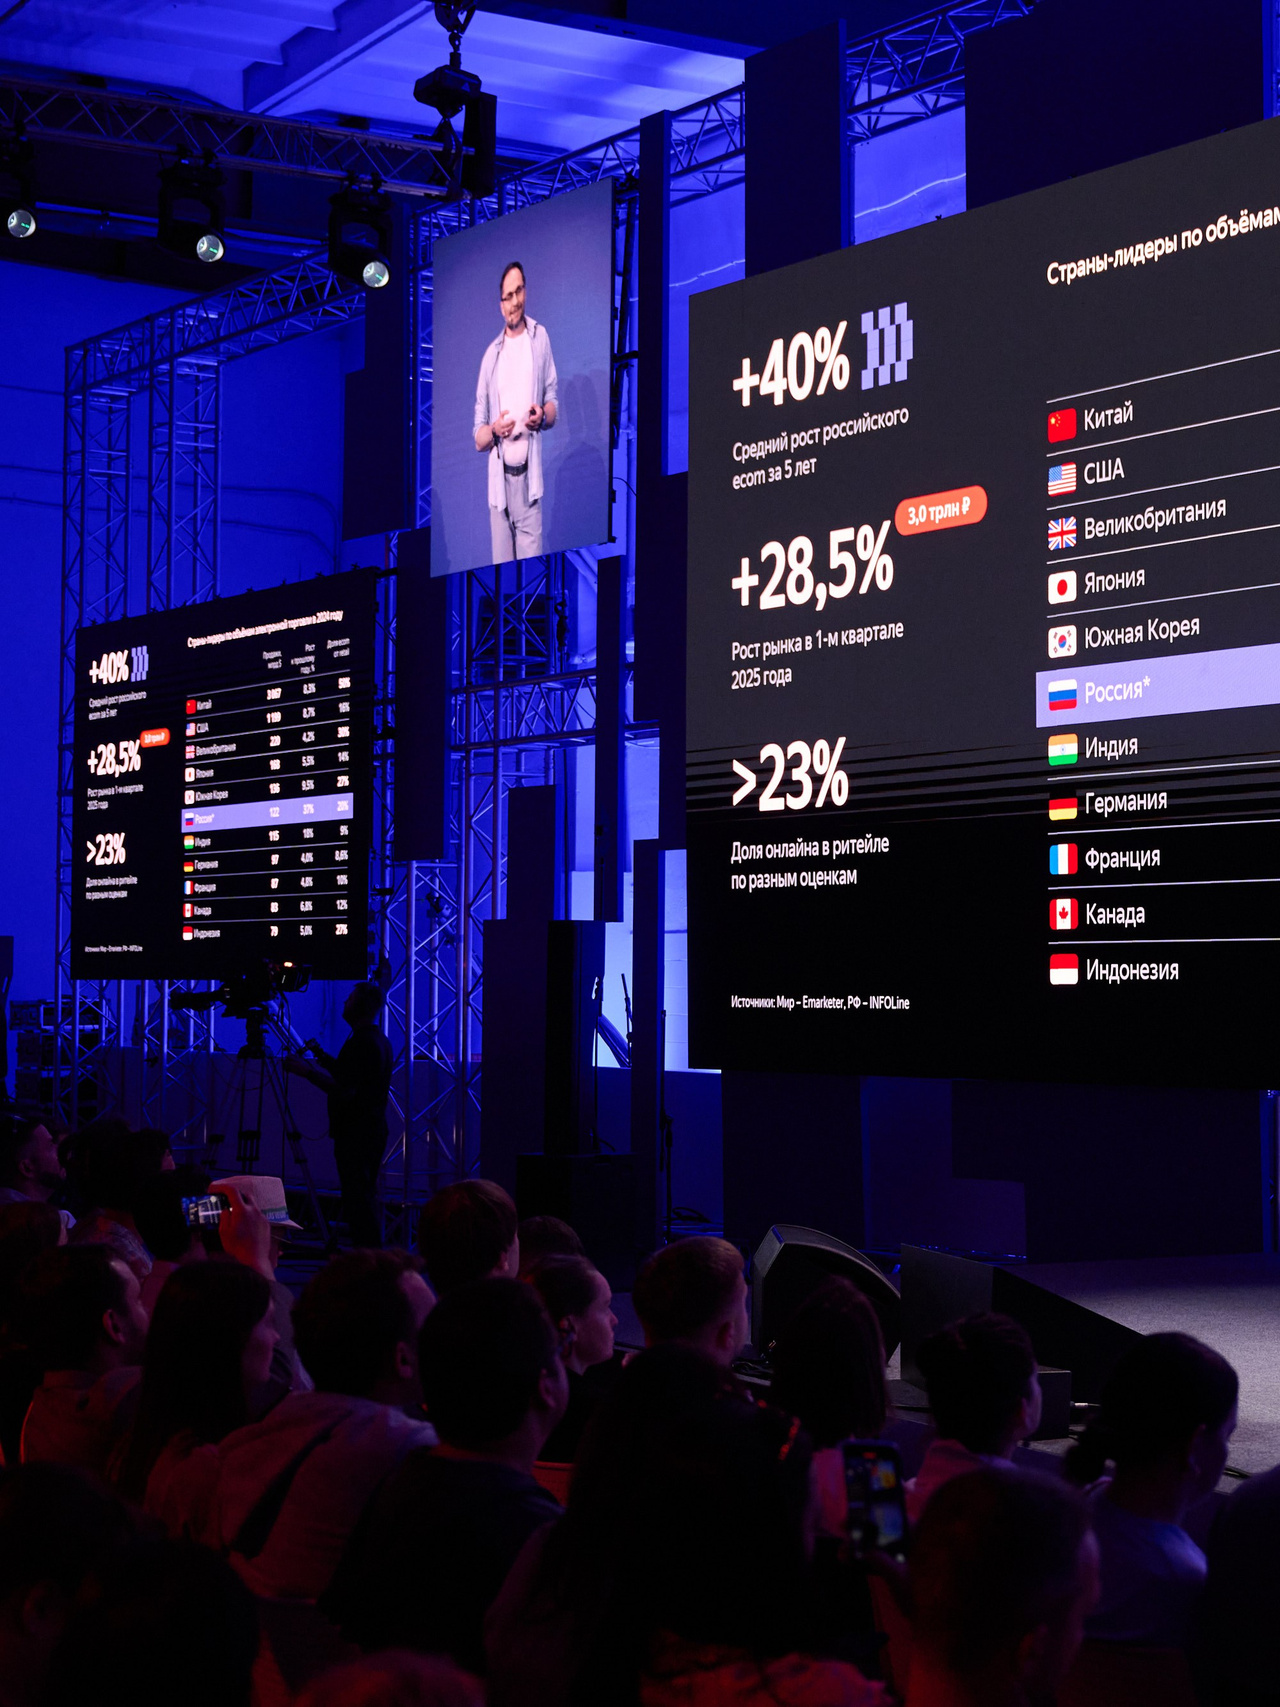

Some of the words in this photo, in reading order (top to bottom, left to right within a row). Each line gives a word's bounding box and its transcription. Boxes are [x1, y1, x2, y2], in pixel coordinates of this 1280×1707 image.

[1046, 234, 1178, 286] Страны-лидеры
[1181, 228, 1203, 250] по
[732, 320, 850, 407] +40%
[1084, 399, 1133, 431] Китай
[732, 431, 789, 465] Средний
[790, 427, 821, 454] рост
[822, 407, 910, 446] российского
[732, 469, 766, 490] ecom
[767, 465, 782, 483] за
[784, 458, 793, 479] 5
[794, 457, 818, 477] лет
[1083, 457, 1125, 485] США
[907, 504, 928, 526] 3,0
[928, 501, 960, 524] трлн
[1084, 499, 1227, 540] Великобритания
[731, 519, 894, 612] +28,5%
[1084, 569, 1145, 595] Япония
[731, 641, 761, 661] Рост
[762, 636, 803, 661] рынка
[804, 635, 813, 651] в
[815, 629, 839, 649] 1-м
[841, 622, 904, 648] квартале
[1085, 625, 1144, 649] Южная
[1147, 617, 1200, 644] Корея
[89, 649, 128, 684] +40%
[731, 667, 761, 690] 2025
[763, 667, 793, 688] года
[87, 739, 140, 777] +28,5%
[1085, 736, 1138, 761] Индия
[732, 736, 849, 812] >23%
[1085, 791, 1168, 818] Германия
[87, 832, 125, 865] >23%
[730, 841, 764, 865] Доля
[765, 837, 820, 859] онлайна
[822, 840, 830, 856] в
[832, 833, 890, 860] ритейле
[1085, 847, 1161, 874] Франция
[731, 874, 747, 890] по
[748, 871, 798, 894] разным
[799, 869, 858, 890] оценкам
[1086, 902, 1146, 929] Канада
[1086, 958, 1179, 985] Индонезия
[731, 994, 776, 1009] Источники:
[776, 994, 795, 1012] Мир
[802, 994, 847, 1011] Emarketer,
[847, 995, 862, 1009] РФ
[869, 995, 911, 1010] INFOLine
